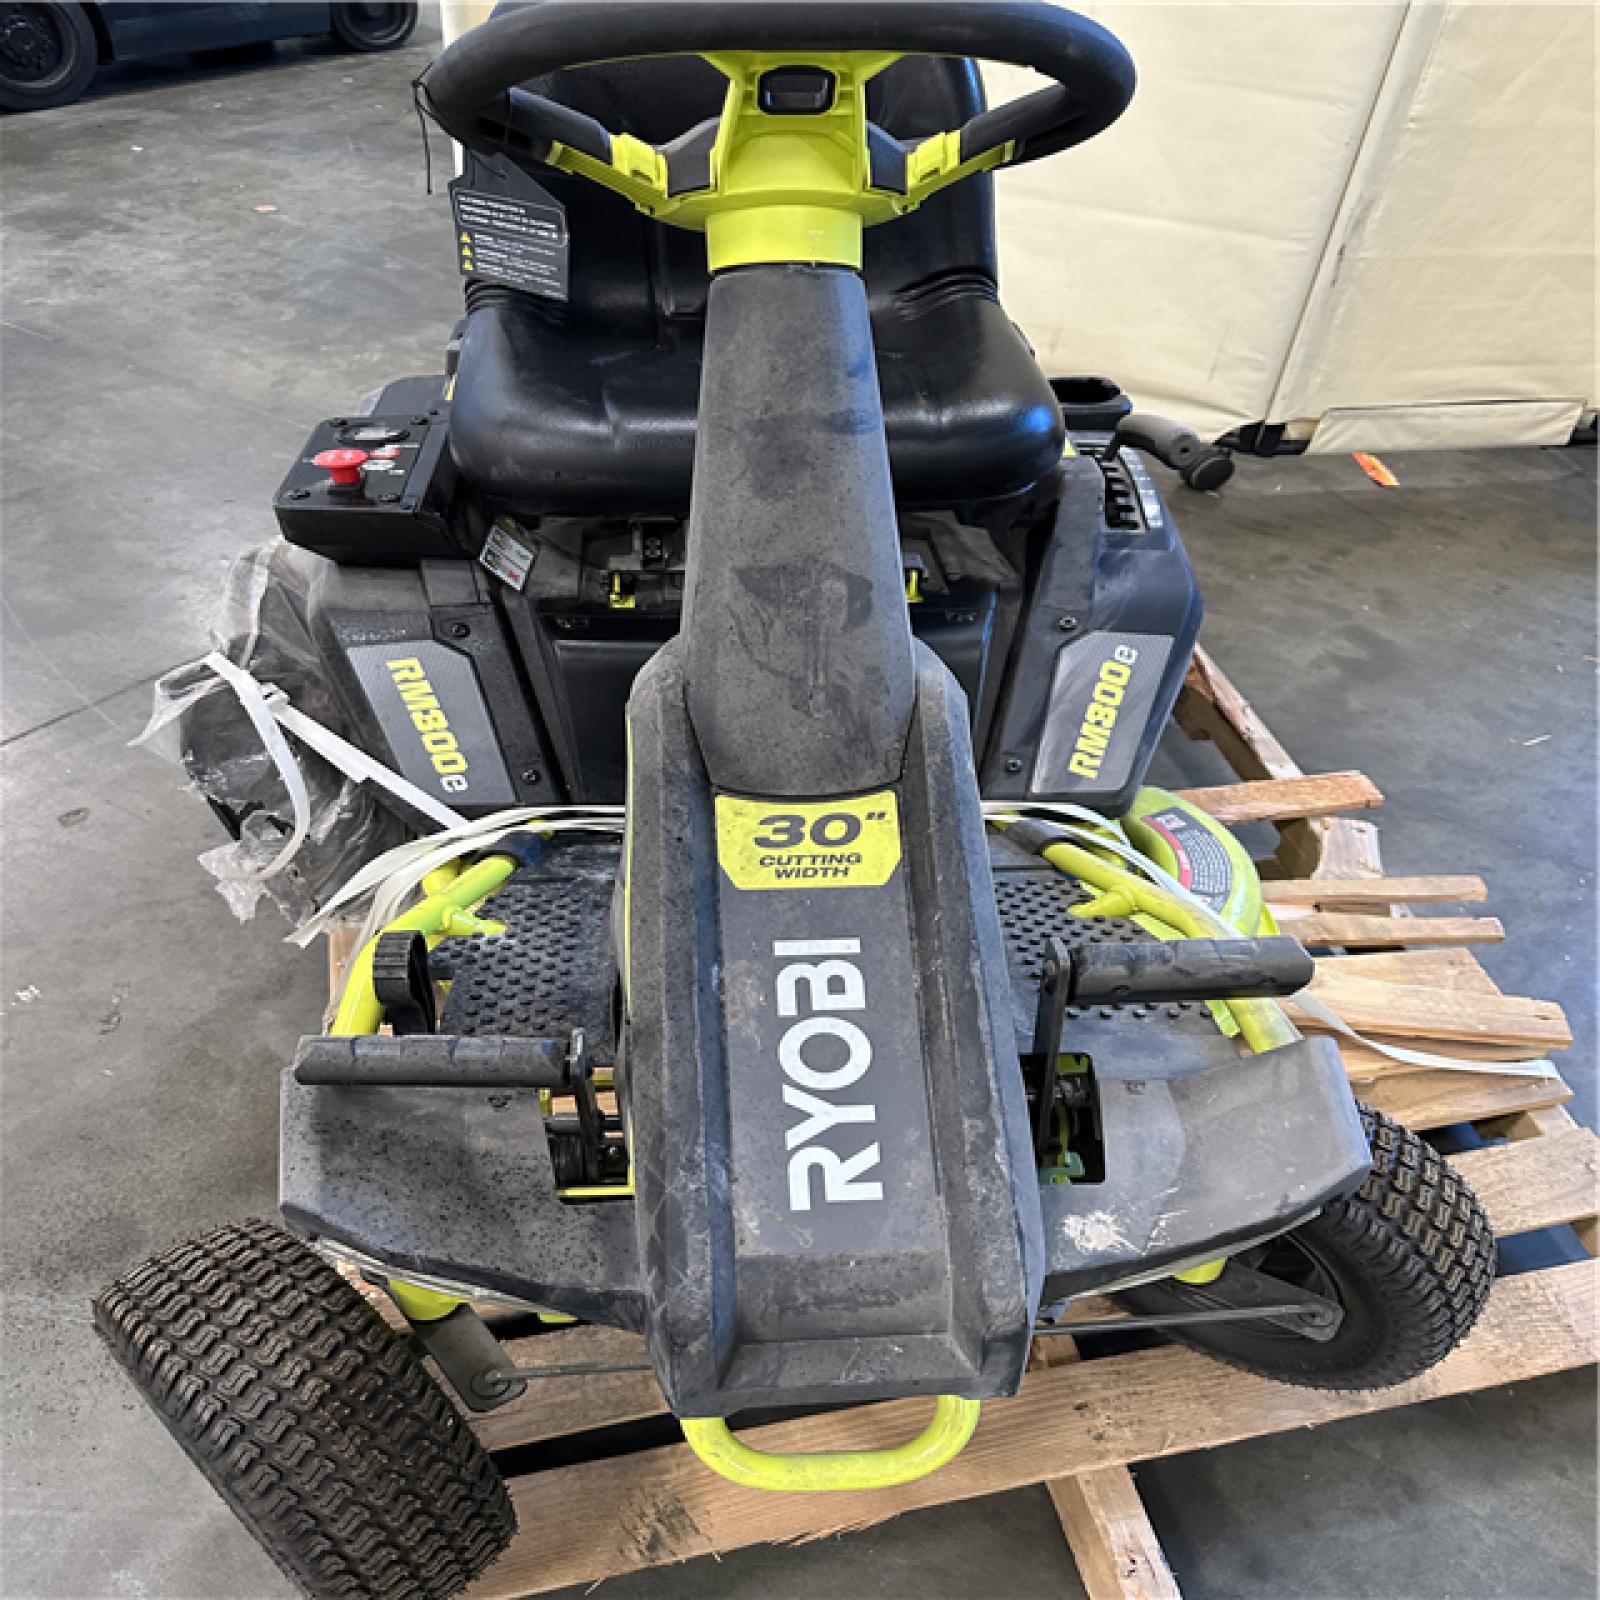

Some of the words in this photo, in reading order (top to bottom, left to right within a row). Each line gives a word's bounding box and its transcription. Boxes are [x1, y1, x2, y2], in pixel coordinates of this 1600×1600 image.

[753, 811, 886, 848] 30"
[759, 853, 862, 866] CUTTING
[774, 867, 849, 879] WIDTH
[773, 937, 884, 1212] RYOBI
